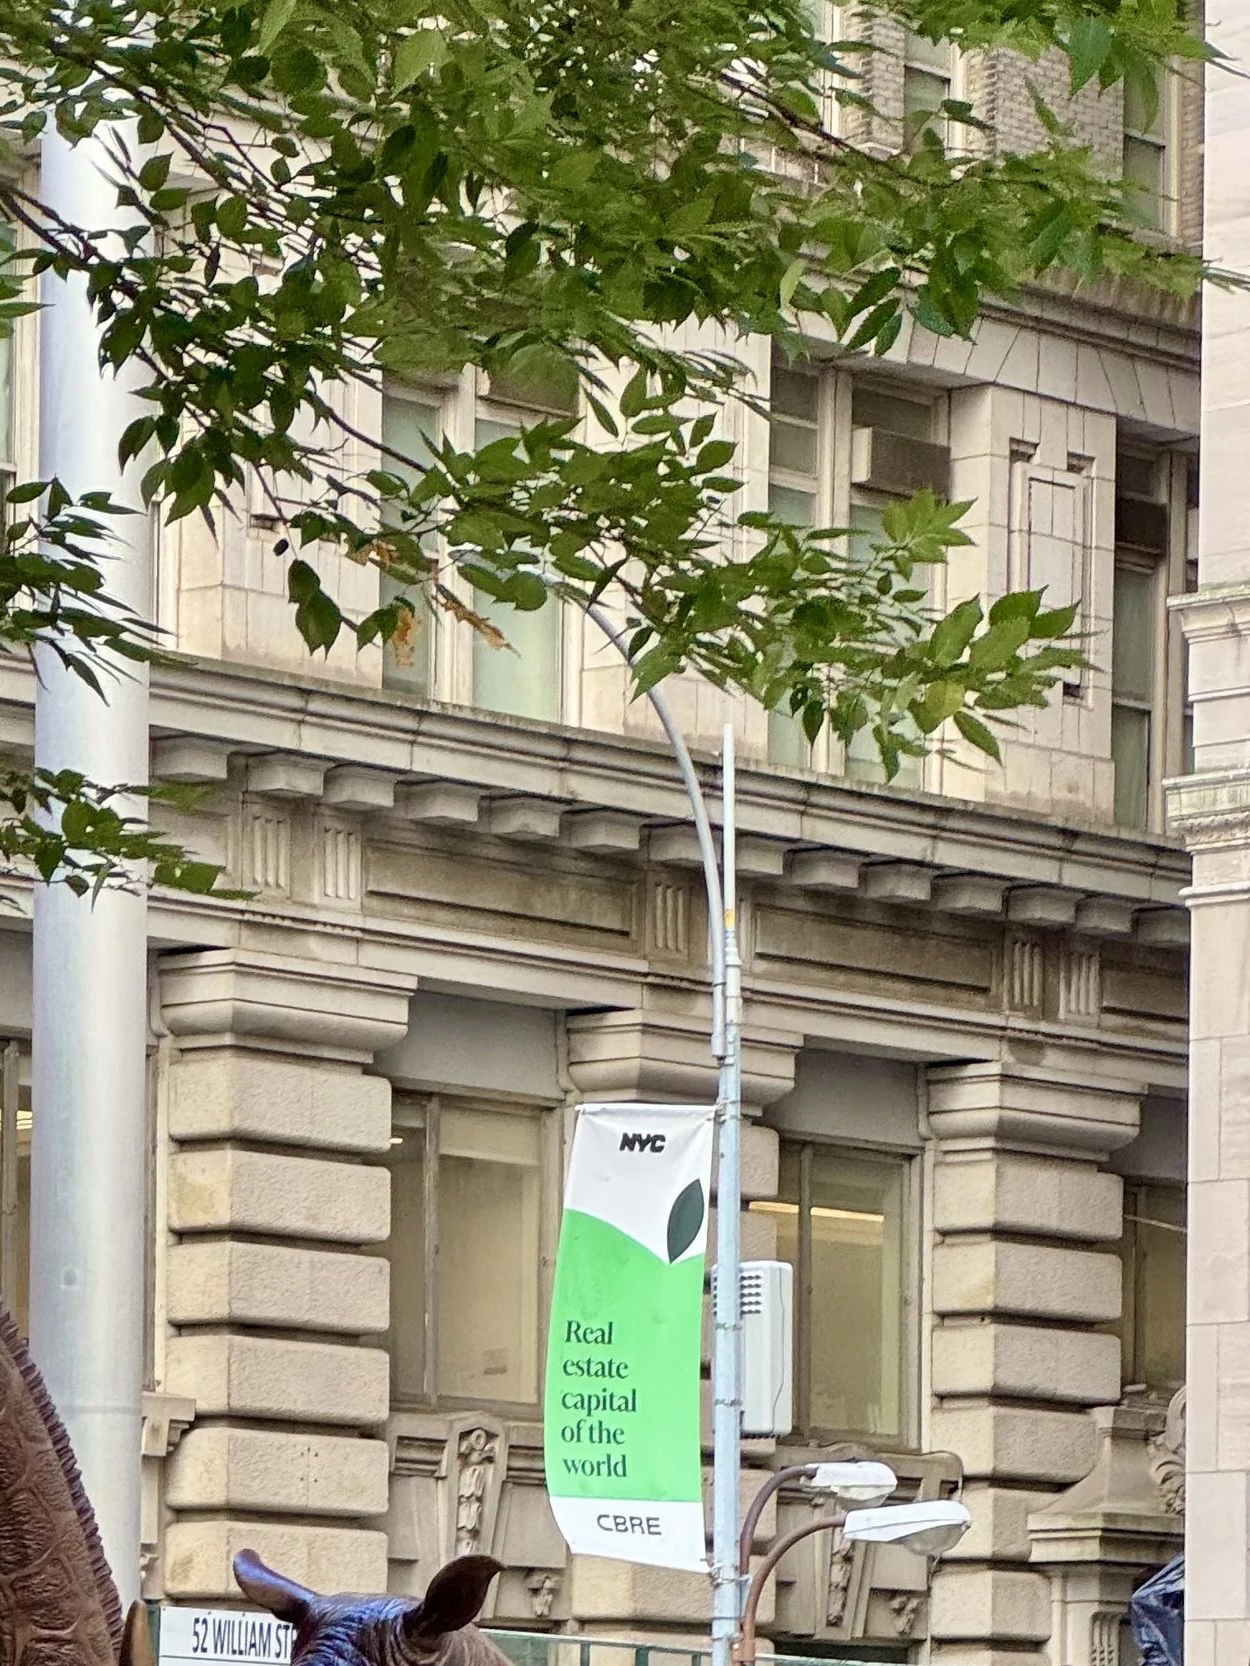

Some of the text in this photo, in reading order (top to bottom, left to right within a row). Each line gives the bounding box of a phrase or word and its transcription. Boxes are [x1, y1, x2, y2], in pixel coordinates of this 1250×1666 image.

[620, 1132, 666, 1153] NYC
[565, 1320, 613, 1345] Real
[562, 1357, 629, 1379] estate
[561, 1387, 637, 1417] capital
[561, 1418, 626, 1445] of the
[562, 1453, 627, 1477] world
[597, 1514, 662, 1535] CBRE
[192, 1617, 208, 1654] 52
[213, 1618, 271, 1658] WILLIAM
